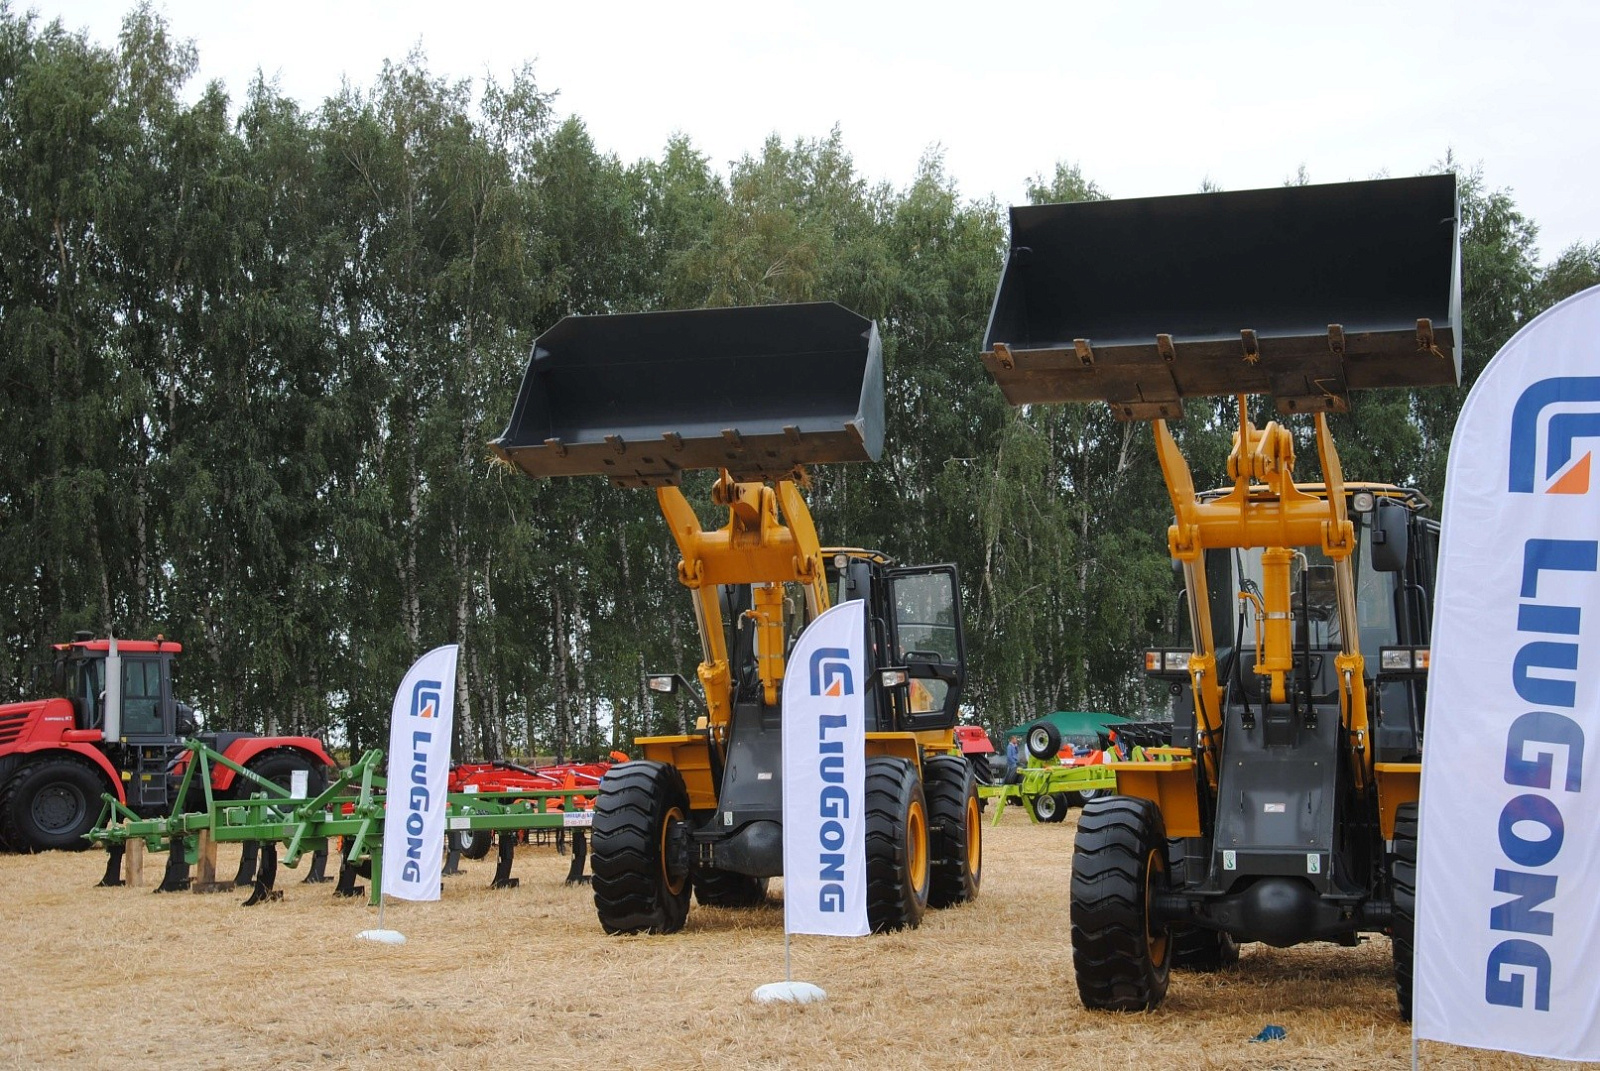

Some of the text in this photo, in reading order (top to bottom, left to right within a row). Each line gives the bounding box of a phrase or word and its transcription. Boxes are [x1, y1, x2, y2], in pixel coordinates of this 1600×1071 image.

[403, 731, 432, 883] LIUGONG
[819, 714, 850, 913] LIUGONG
[1485, 538, 1599, 1012] LIUGONG
